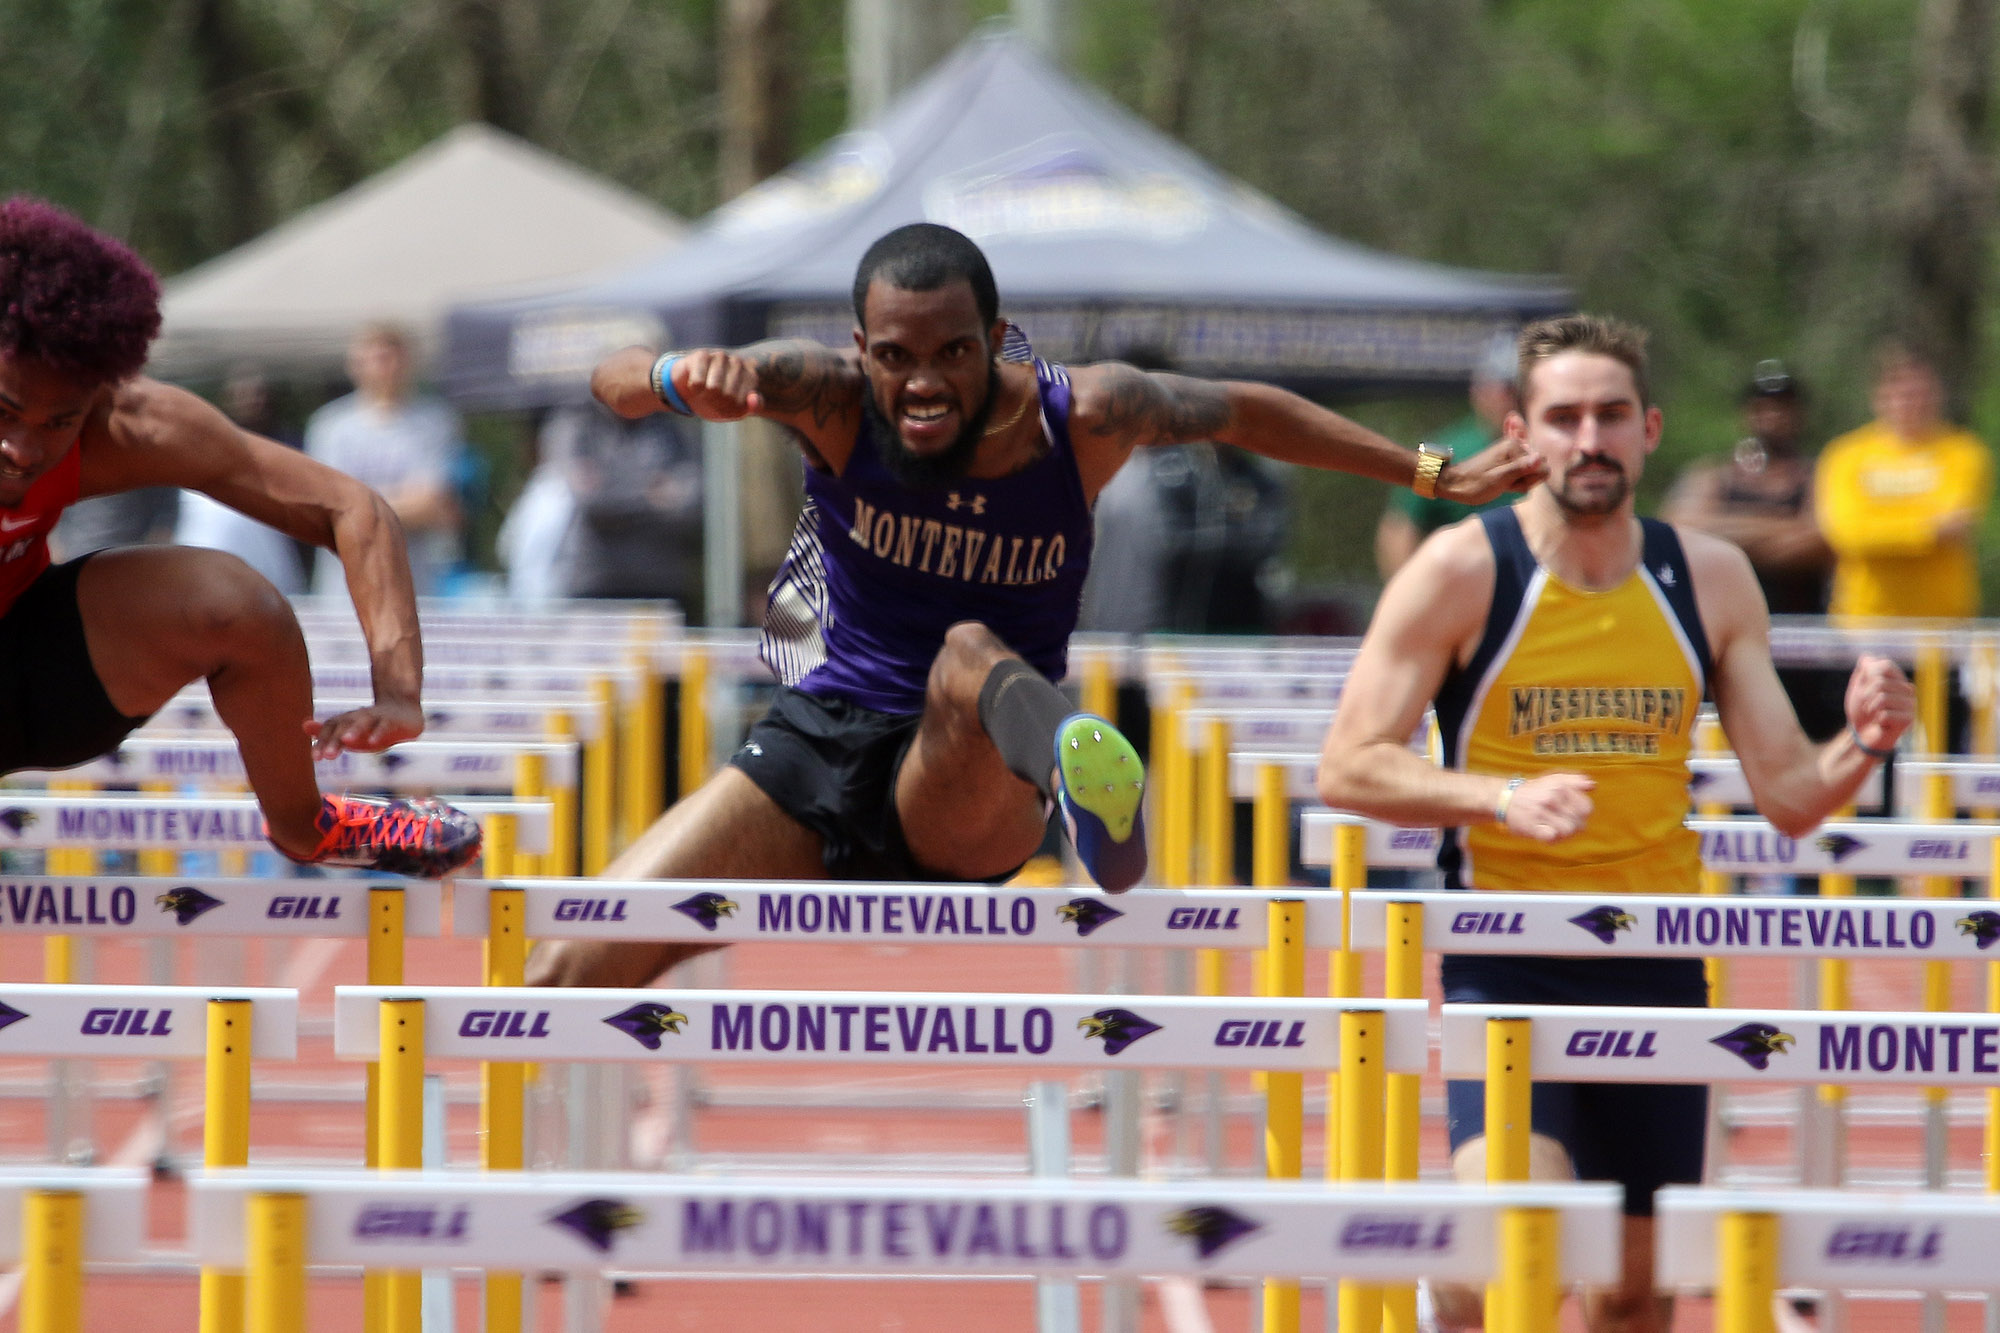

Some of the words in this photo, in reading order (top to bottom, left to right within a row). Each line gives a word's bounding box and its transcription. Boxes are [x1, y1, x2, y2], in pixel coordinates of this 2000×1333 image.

[849, 497, 1066, 584] MONTEVALLO
[1509, 687, 1686, 737] MISSISSIPPI
[1534, 731, 1660, 756] COLLEGE
[56, 806, 267, 841] MONTEVALL
[0, 885, 135, 926] VALLO
[266, 896, 340, 920] GILL
[554, 898, 628, 922] GILL
[758, 893, 1036, 936] MONTEVALLO
[1167, 907, 1241, 931] GILL
[1451, 911, 1526, 935] GILL
[1656, 906, 1936, 949] MONTEVALLO
[80, 1007, 173, 1036] GILL
[458, 1010, 551, 1038] GILL
[711, 1003, 1054, 1055] MONTEVALLO
[1214, 1020, 1306, 1048] GILL
[1565, 1030, 1658, 1058] GILL
[1819, 1023, 1999, 1073] MONTE
[681, 1198, 1130, 1261] MONTEVALLO
